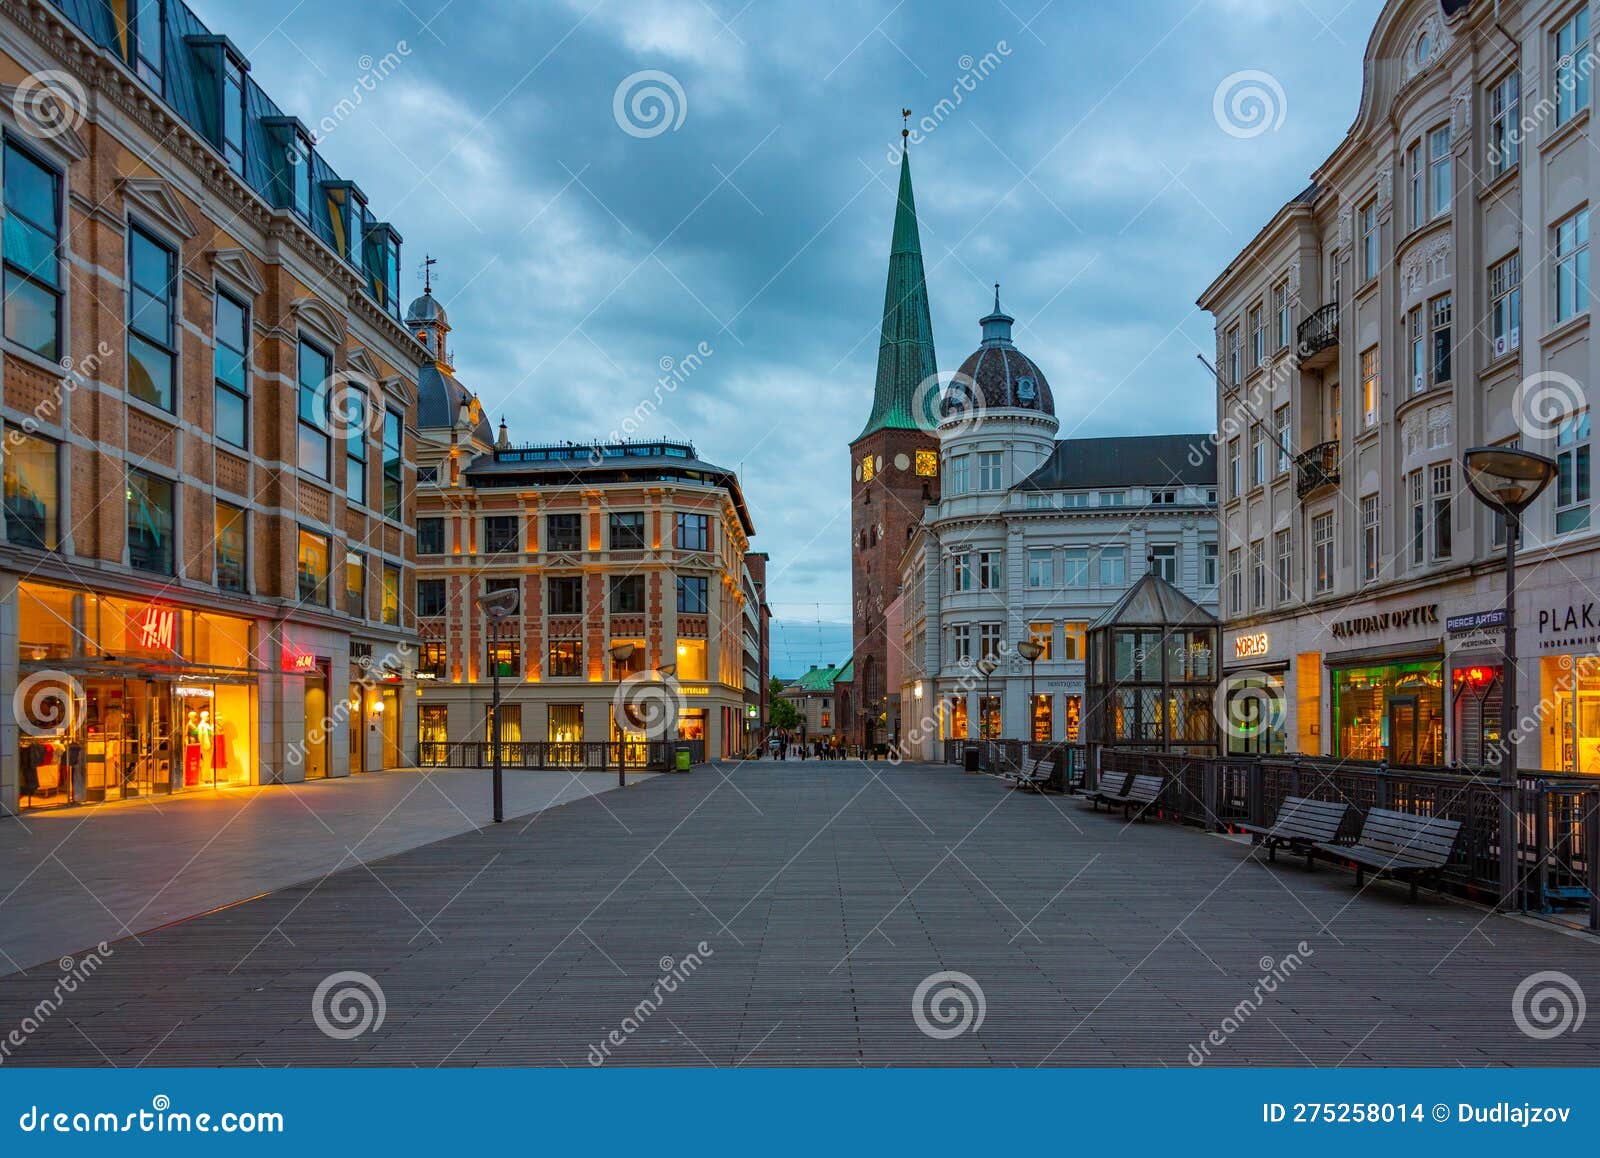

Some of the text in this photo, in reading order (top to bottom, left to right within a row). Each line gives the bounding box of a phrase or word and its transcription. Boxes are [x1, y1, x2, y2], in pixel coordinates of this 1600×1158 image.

[142, 607, 173, 649] H&M
[1332, 604, 1439, 639] PALUDAN OPTIK
[1447, 612, 1503, 629] PIERCE ARTIST
[1539, 602, 1600, 634] PLAK
[1235, 633, 1268, 657] NORLYS
[296, 655, 313, 667] H&M
